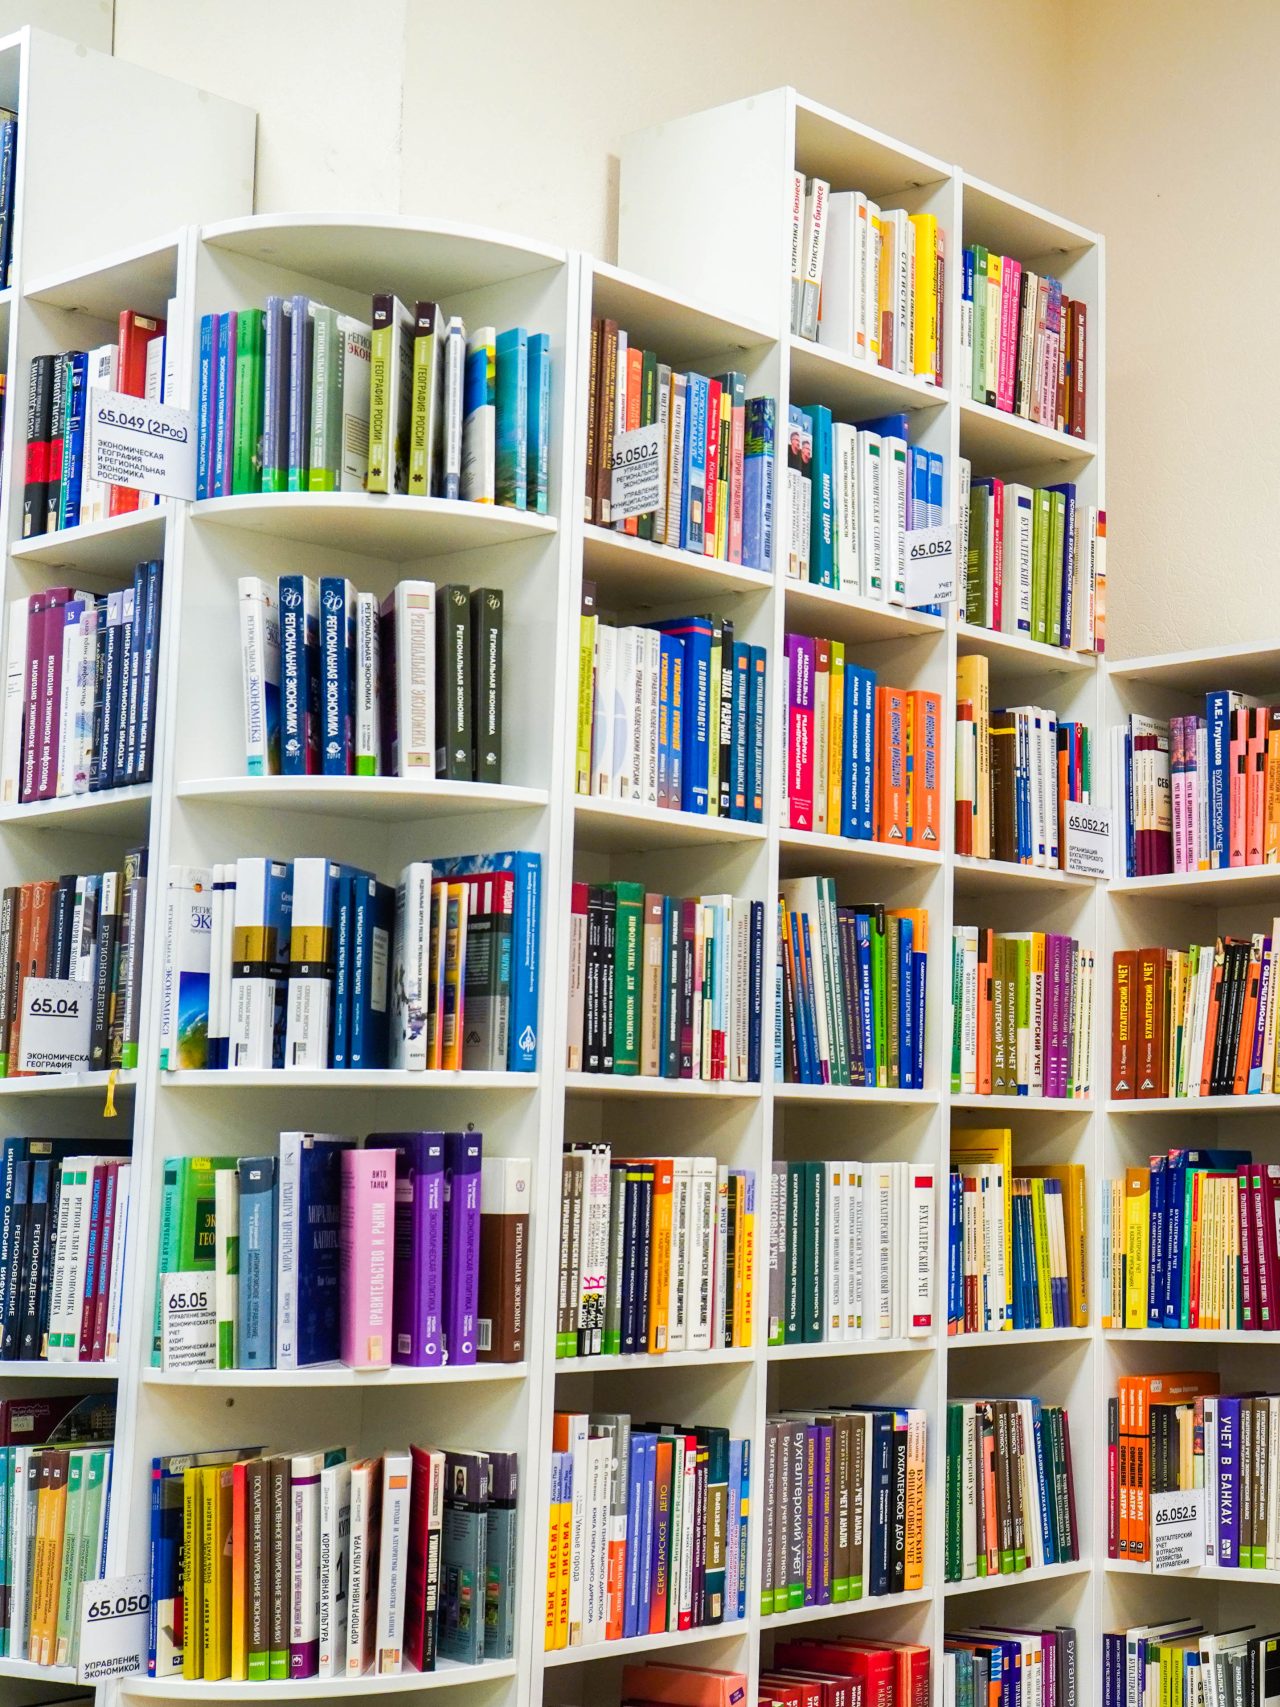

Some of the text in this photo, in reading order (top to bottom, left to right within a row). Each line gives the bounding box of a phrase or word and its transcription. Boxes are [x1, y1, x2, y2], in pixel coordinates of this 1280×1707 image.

[97, 440, 164, 460] ЭКОНОМИЧЕСКАЯ
[98, 408, 188, 442] 65.049 (2Рос)
[98, 448, 142, 462] ГЕОГРАФИЯ
[97, 463, 144, 479] ЭКОНОМИКА
[97, 471, 129, 483] РОССИИ
[822, 473, 831, 544] МНОГО ЦИФР
[911, 540, 952, 557] 65.052
[1020, 516, 1029, 611] БУХГАЛТЕРСКИЙ УЧЕТ
[934, 591, 952, 599] АУДИТ
[938, 581, 952, 589] УЧЕТ
[120, 661, 129, 735] ЭКОНОМИЧЕСКИХ
[285, 613, 298, 734] РЕГИОНАЛЬНАЯ ЭКОНОМИКА
[327, 615, 338, 736] РЕГИОНАЛЬНАЯ ЭКОНОМИКА
[698, 660, 706, 741] ДЕЛОПРОИЗВОДСТВО
[721, 668, 732, 745] ЭПОХА РАЗРЫВА
[101, 665, 113, 771] ИСТОРИЯ ЭКОНОМИЧЕСКИХ
[1213, 698, 1223, 766] И.Е. Глушков
[1069, 816, 1109, 834] 65.052.21
[31, 998, 79, 1015] 65.04
[95, 925, 110, 1031] РЕГИОНОВЕДЕНИЕ
[626, 916, 636, 1050] ИНФОРМАТИКА ДЛЯ ЭКОНОМИСТОВ
[1118, 964, 1129, 1040] БУХГАЛТЕРСКИЙ УЧЕТ
[1143, 962, 1153, 1039] БУХГАЛТЕРСКИЙ УЧЕТ
[1258, 964, 1270, 1032] СТРОИТЕЛЬСТВО
[26, 1060, 72, 1069] ГЕОГРАФИЯ
[371, 1181, 389, 1189] ТАНЦИ
[372, 1170, 387, 1179] ВИТО
[9, 1225, 21, 1316] РЕГИОНОВЕДЕНИЕ
[28, 1224, 41, 1316] РЕГИОНОВЕДЕНИЕ
[368, 1202, 386, 1326] ПРАВИТЕЛЬСТВО РЫНКИ
[918, 1205, 929, 1298] БУХГАЛТЕРСКИЙ УЧЕТ
[169, 1292, 207, 1309] 65.05
[791, 1433, 804, 1576] Бухгалтерский учет
[896, 1446, 906, 1550] БУХГАЛТЕРСКОЕ ДЕЛО
[1220, 1416, 1232, 1525] УЧЕТ БАНКАХ
[1156, 1506, 1196, 1523] 65.052.5
[1156, 1531, 1193, 1542] БУХГАЛТЕРСКИЙ
[321, 1533, 330, 1643] КОРПОРАТИВНАЯ КУЛЬТУРА
[351, 1535, 362, 1645] КОРПОРАТИВНАЯ КУЛЬТУРА
[426, 1534, 439, 1611] НОВАЯ ЭКОНОМИКА
[656, 1521, 666, 1595] СЕКРЕТАРСКОЕ
[88, 1594, 149, 1618] 65.050
[84, 1663, 140, 1679] ЭКОНОМИКОЙ
[85, 1654, 140, 1669] УПРАВЛЕНИЕ
